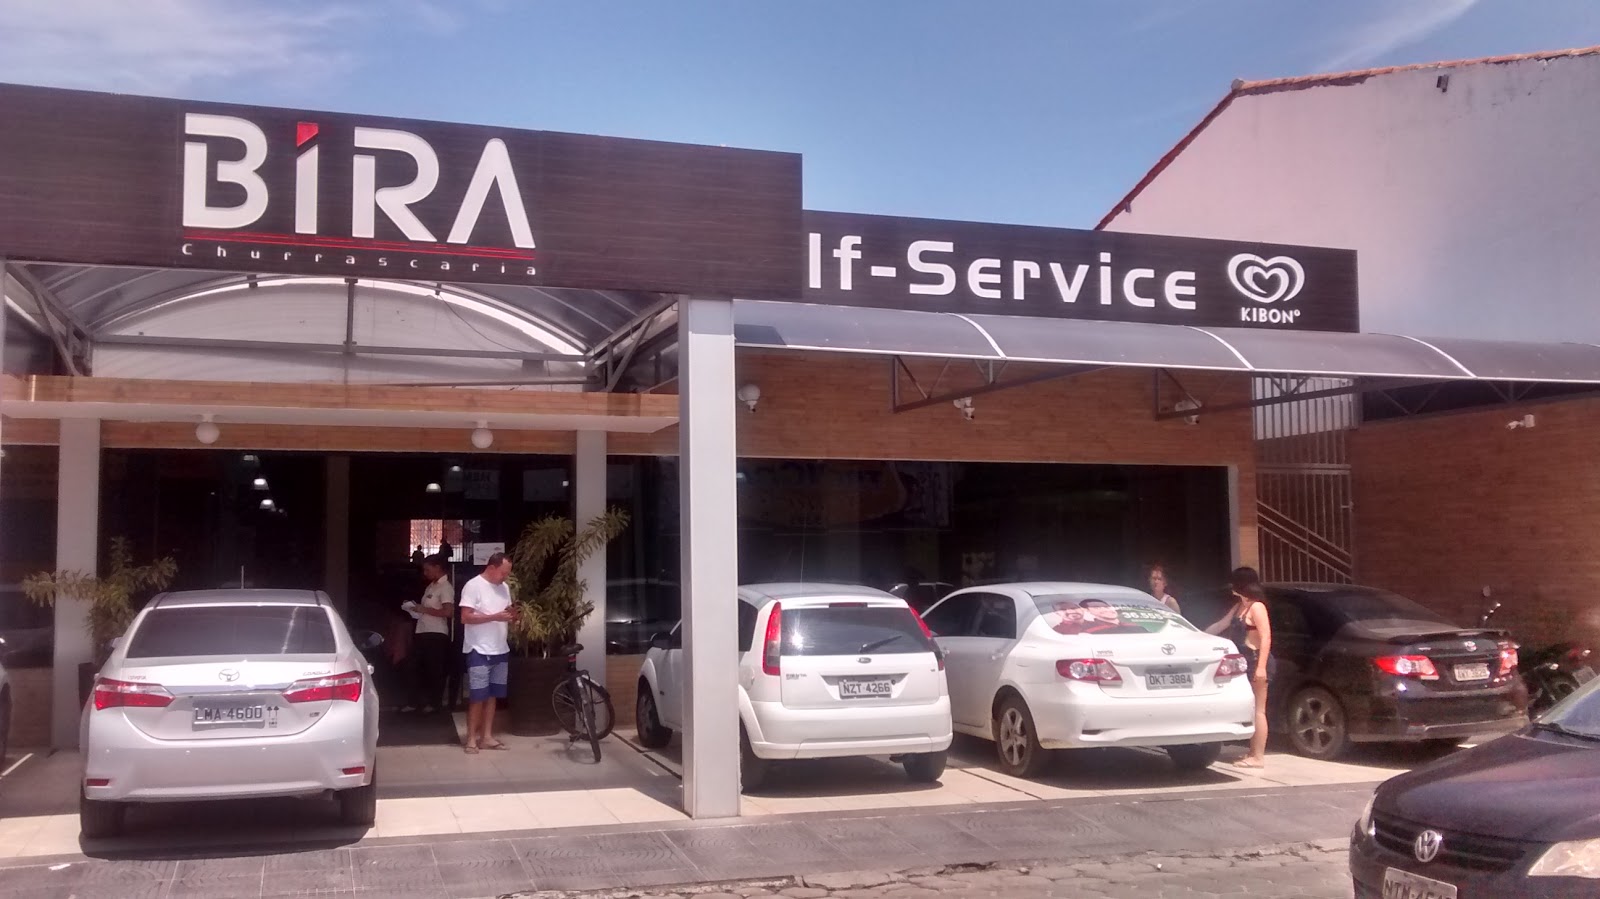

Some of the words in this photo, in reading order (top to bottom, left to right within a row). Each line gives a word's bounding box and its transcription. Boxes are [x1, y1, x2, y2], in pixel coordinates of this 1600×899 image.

[181, 242, 537, 277] Churrascaria
[842, 682, 861, 695] NZT
[865, 682, 891, 694] 4266
